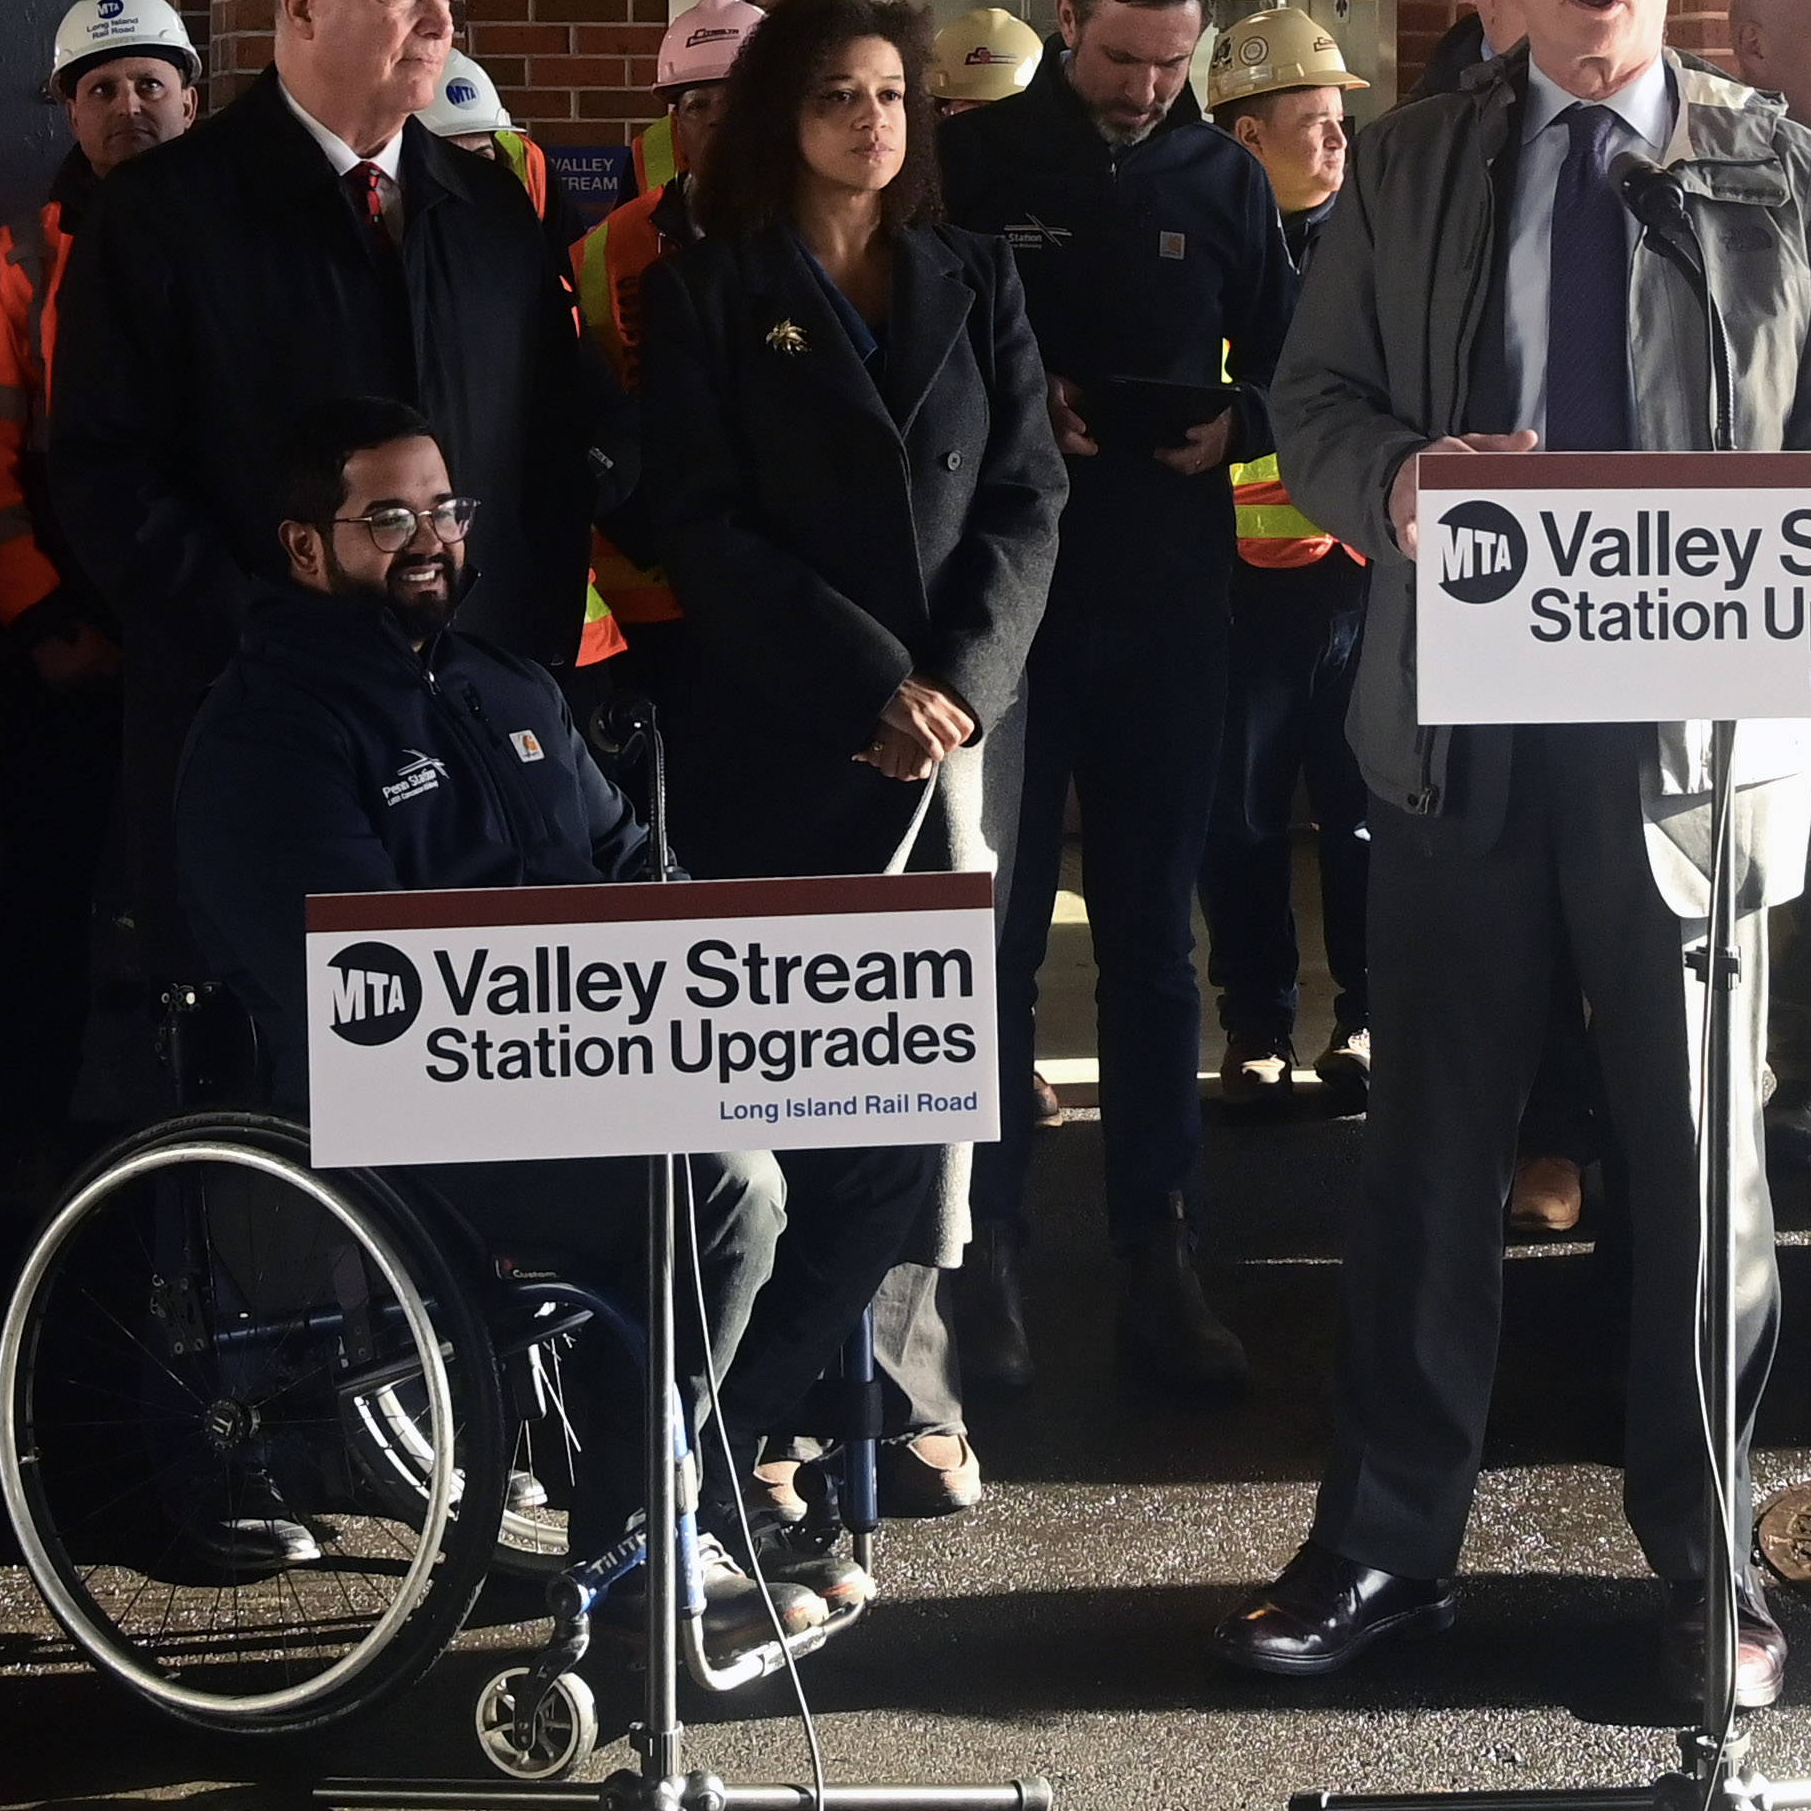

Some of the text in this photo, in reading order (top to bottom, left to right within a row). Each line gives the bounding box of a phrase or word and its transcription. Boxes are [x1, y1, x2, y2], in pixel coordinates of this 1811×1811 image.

[86, 17, 139, 33] Long Island
[97, 2, 121, 16] MTA
[92, 26, 136, 40] Rail Road
[446, 85, 478, 106] MTA
[1438, 522, 1513, 585] MTA
[1539, 509, 1762, 590] Valley
[1529, 586, 1748, 643] Station
[381, 780, 410, 800] Penn
[329, 964, 408, 1027] MTA
[433, 938, 975, 1026] Valley Stream
[425, 1012, 977, 1084] Station Upgrades
[719, 1091, 979, 1125] Long Island Rail Road
[512, 1268, 557, 1279] Custom
